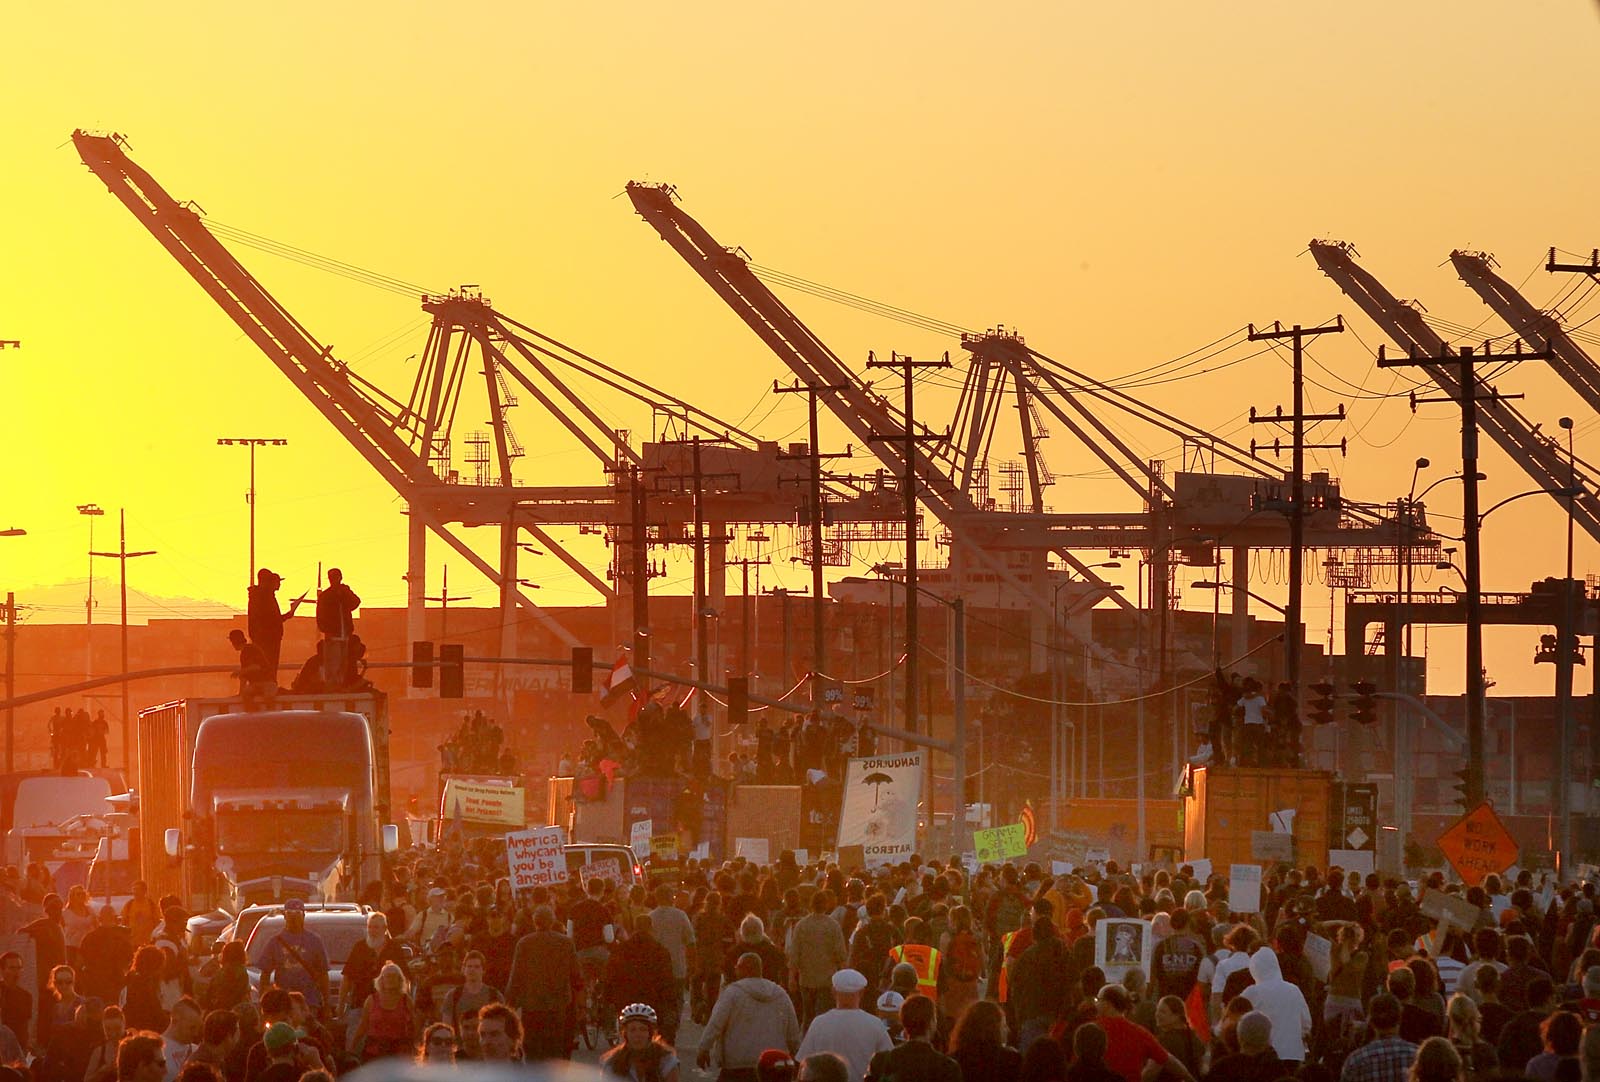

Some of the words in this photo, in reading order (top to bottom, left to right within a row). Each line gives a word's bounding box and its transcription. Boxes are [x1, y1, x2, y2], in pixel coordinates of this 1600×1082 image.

[825, 688, 843, 702] 99%
[508, 834, 559, 849] America
[1464, 839, 1497, 854] WORK
[513, 863, 534, 873] you
[540, 859, 554, 870] be
[516, 869, 566, 885] angelic
